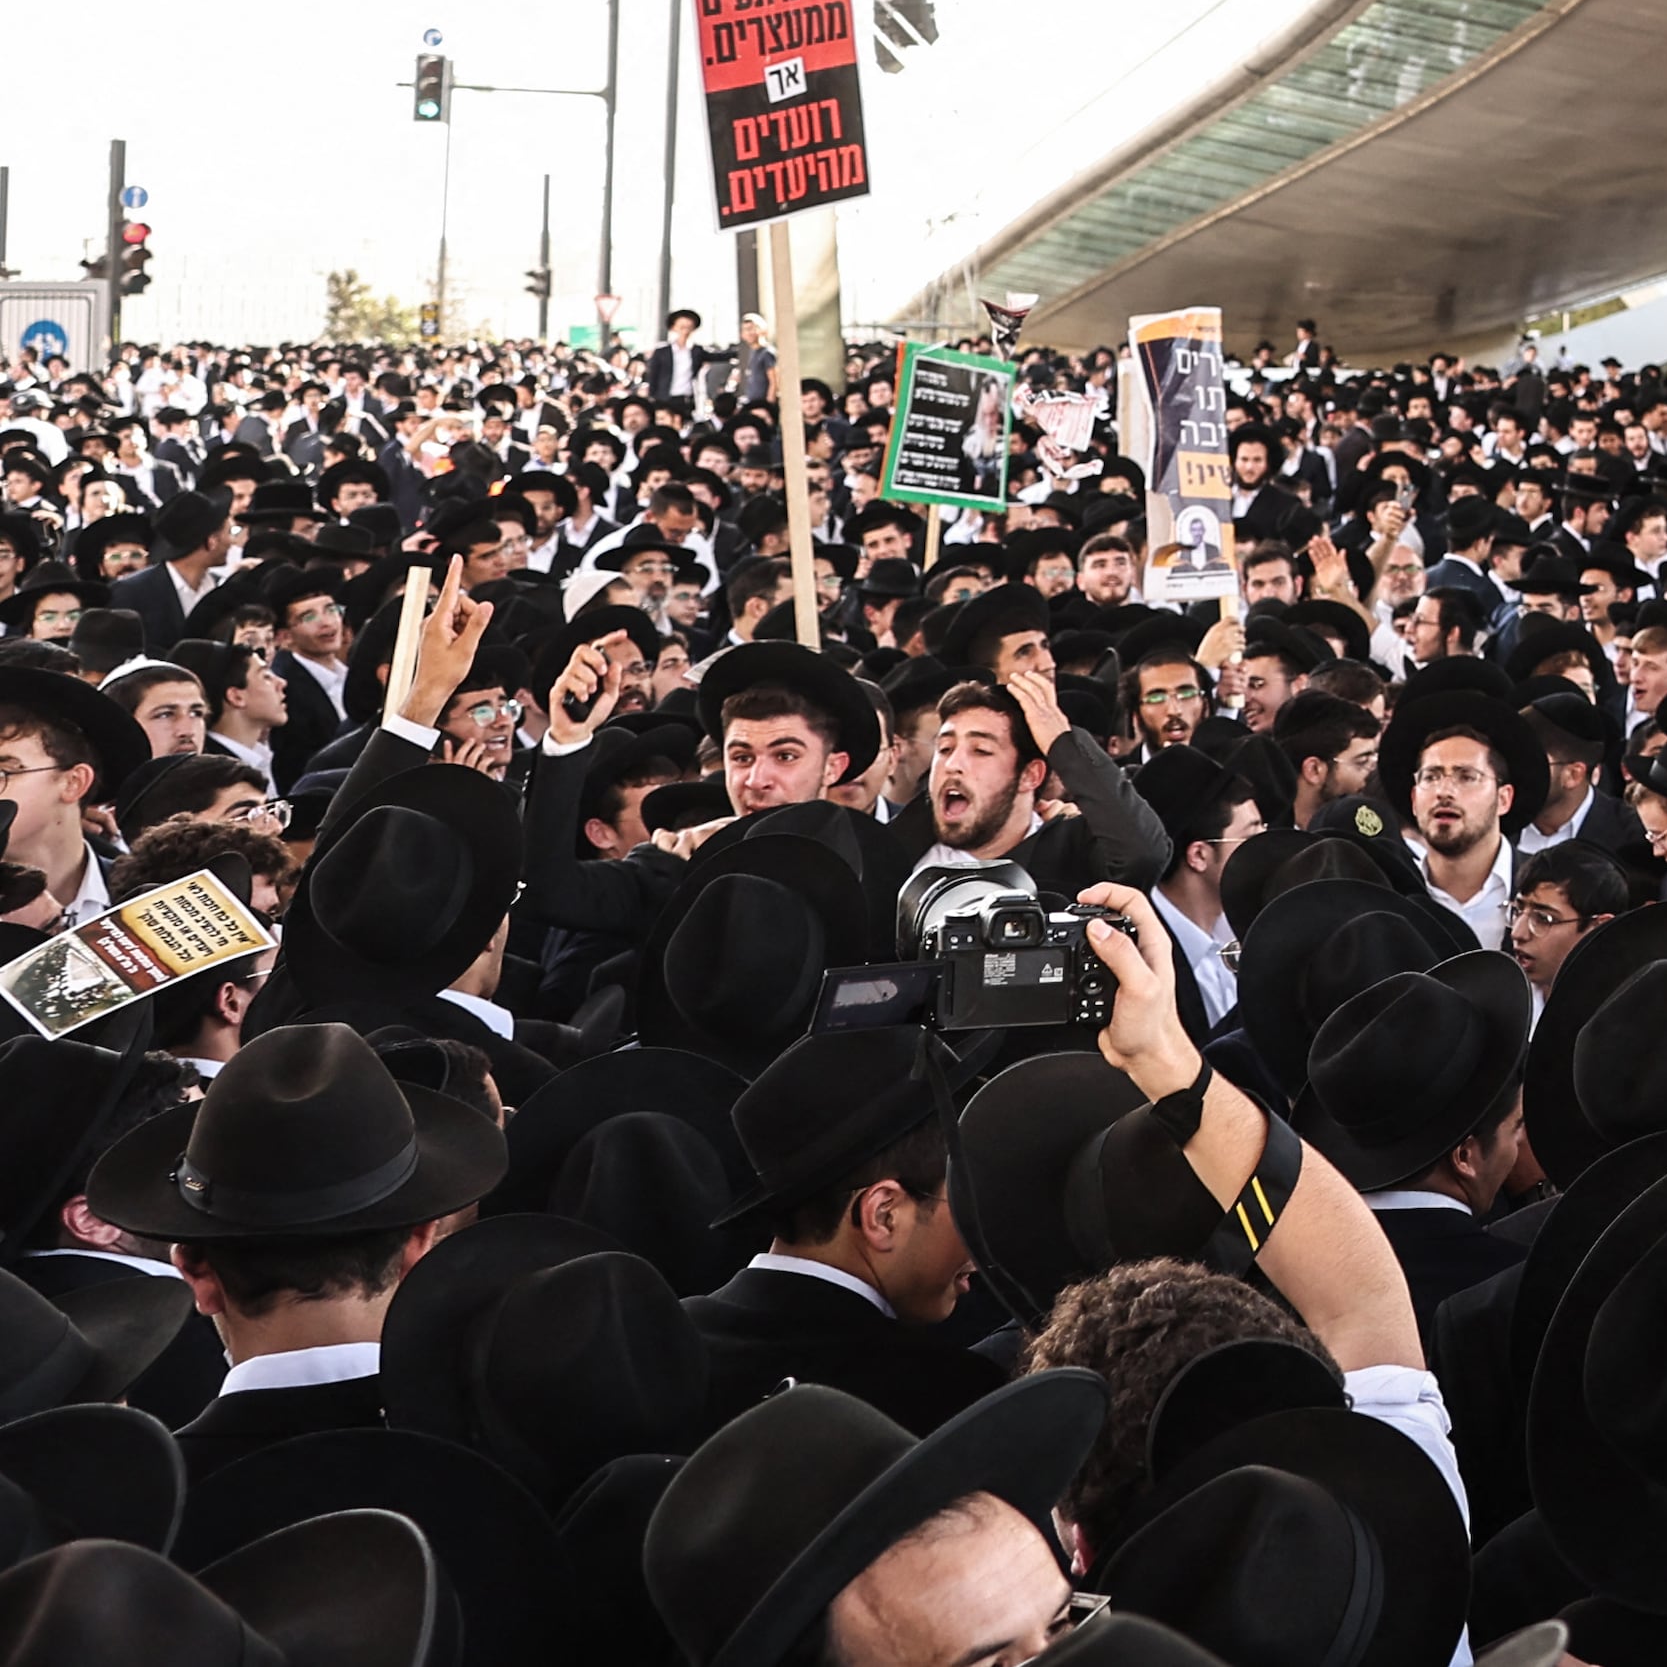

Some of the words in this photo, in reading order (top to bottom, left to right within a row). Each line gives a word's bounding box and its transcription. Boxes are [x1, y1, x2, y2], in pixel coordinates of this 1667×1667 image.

[706, 1, 847, 66] ממעצרים.
[769, 64, 800, 97] אך
[732, 98, 841, 161] רועדים
[721, 144, 865, 216] מהיעדים.
[153, 900, 184, 926] סנקציות
[174, 895, 199, 917] מכסות
[195, 916, 220, 937] להציב
[224, 920, 238, 931] כל
[188, 934, 214, 957] ויעדים
